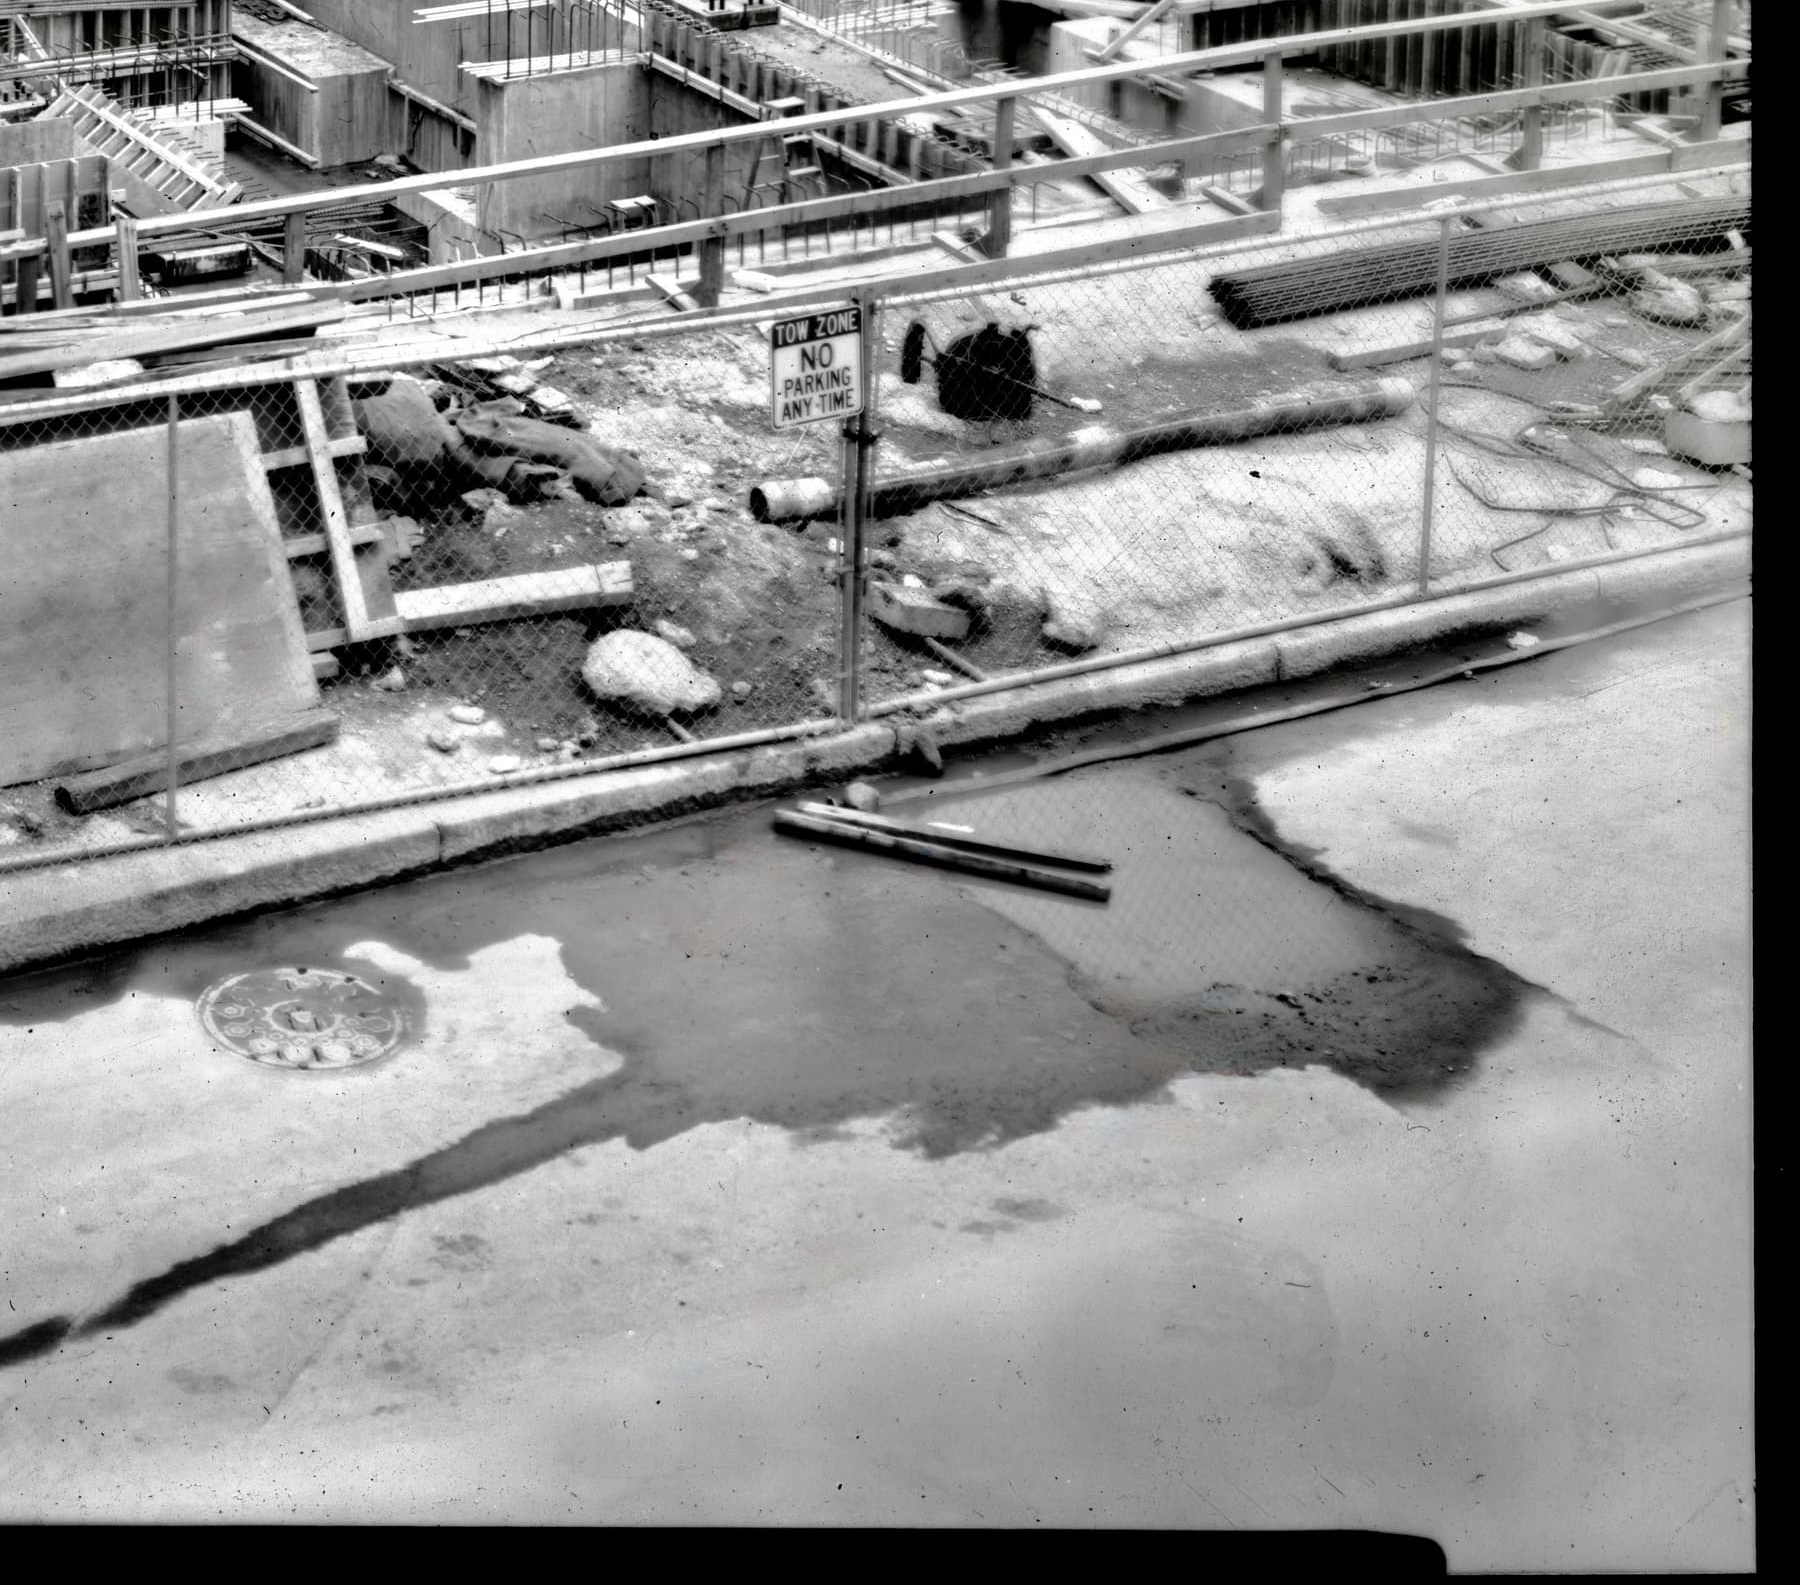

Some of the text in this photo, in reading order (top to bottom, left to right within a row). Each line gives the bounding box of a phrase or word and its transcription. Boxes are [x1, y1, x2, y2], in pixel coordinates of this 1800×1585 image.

[776, 310, 858, 345] TOW ZONE
[801, 343, 833, 372] NO
[784, 367, 850, 399] PARKING
[782, 388, 854, 422] ANY TIME
